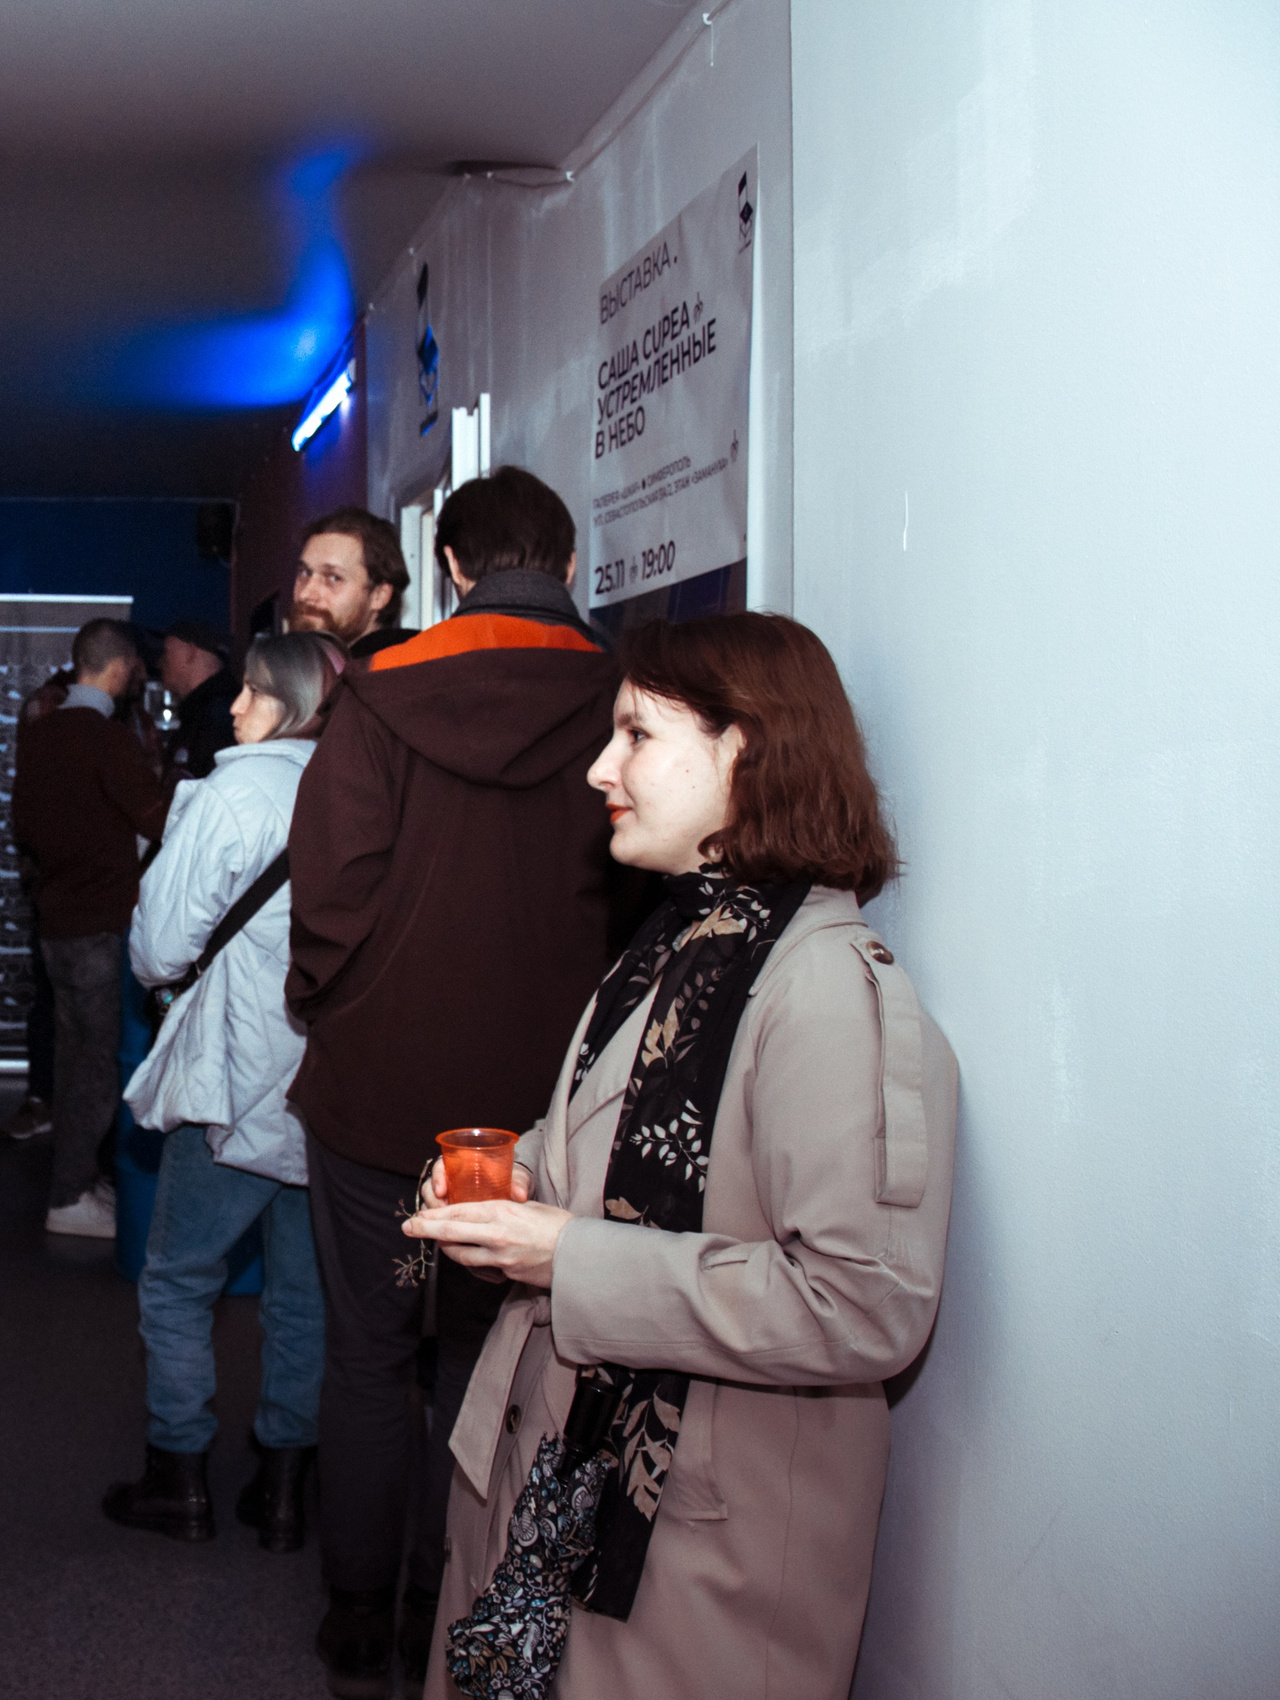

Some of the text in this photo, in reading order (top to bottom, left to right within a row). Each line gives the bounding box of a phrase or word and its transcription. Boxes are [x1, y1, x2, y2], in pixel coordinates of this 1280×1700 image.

[600, 241, 678, 325] ВЫСТАВКА.
[597, 317, 716, 426] УСТРЕМЛЕННЫЕ
[598, 339, 639, 391] САША
[595, 405, 646, 460] В НЕБО
[595, 540, 676, 595] 25.11 19:00
